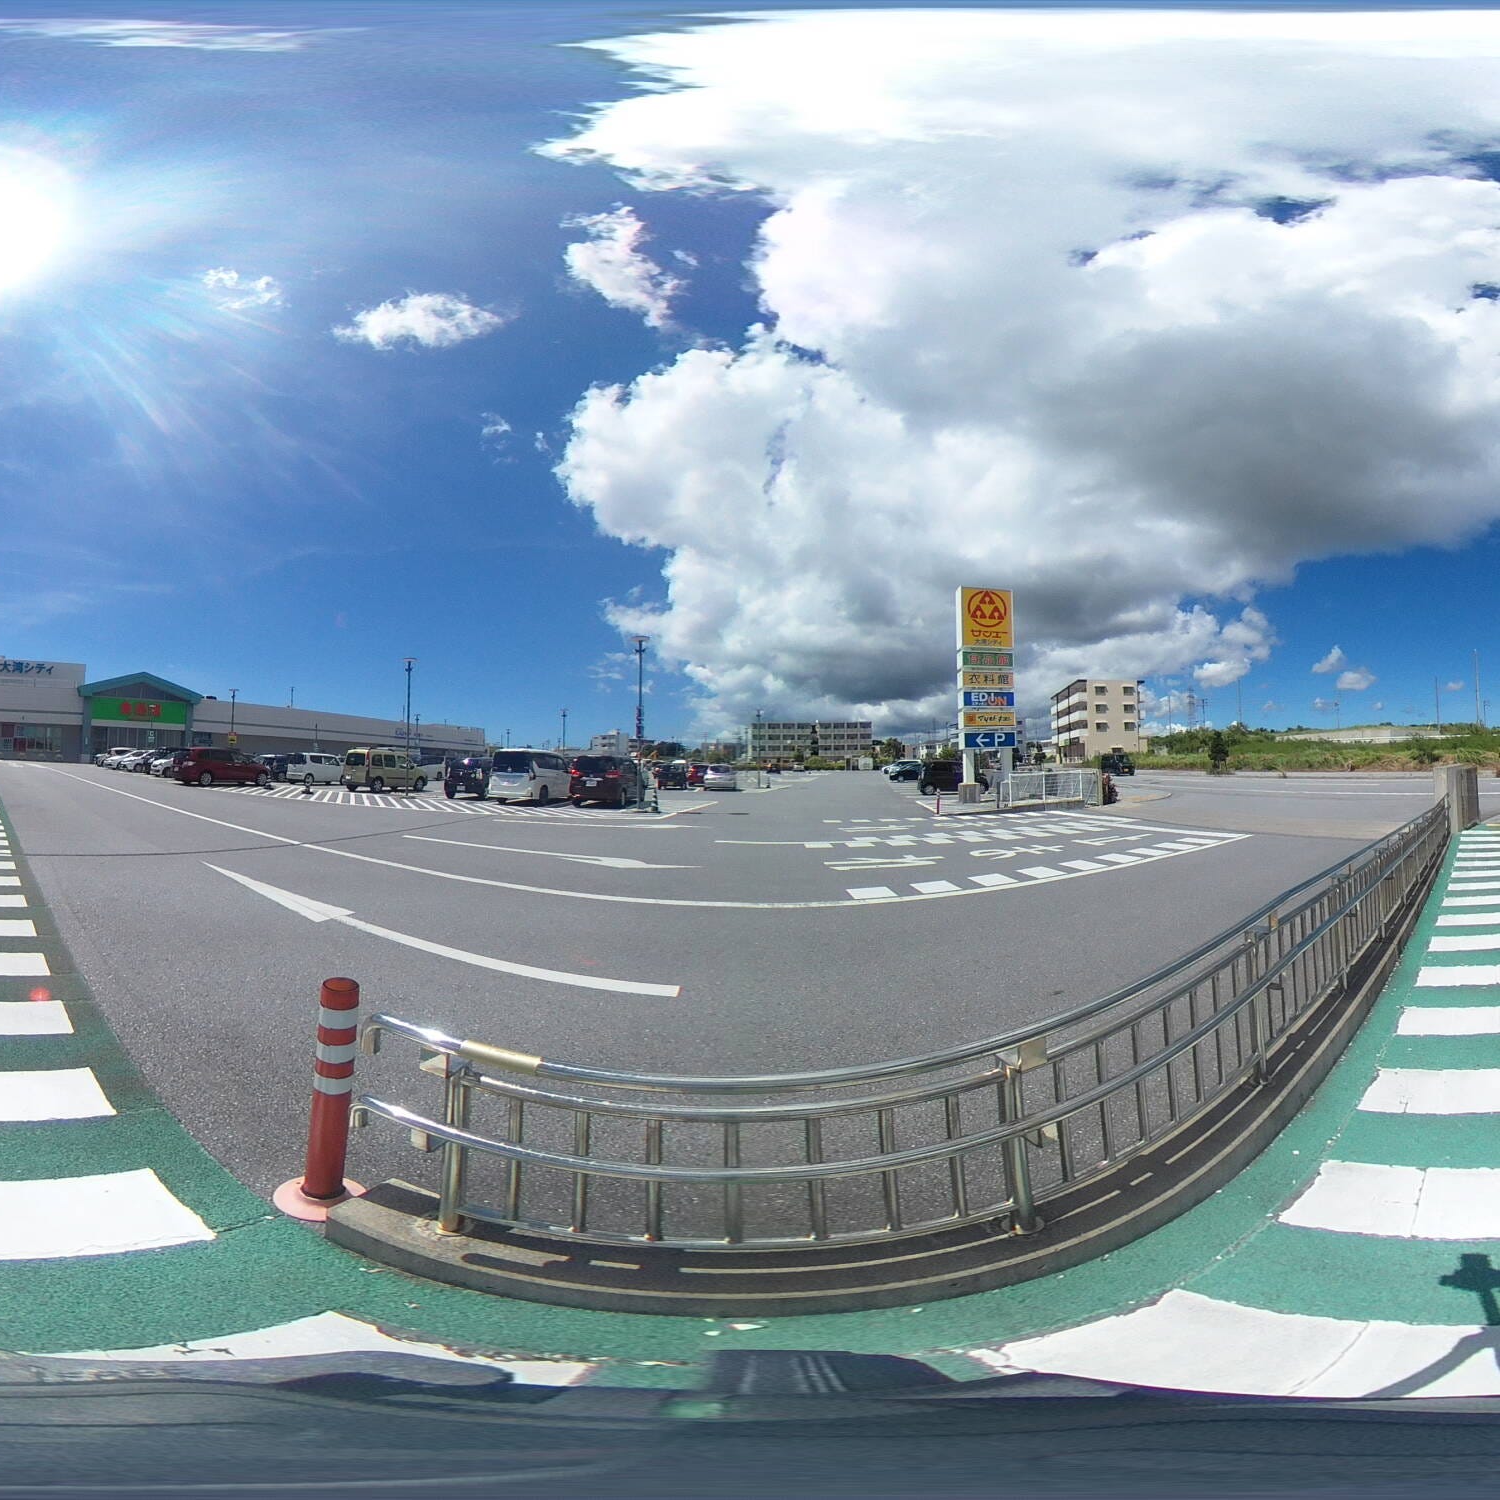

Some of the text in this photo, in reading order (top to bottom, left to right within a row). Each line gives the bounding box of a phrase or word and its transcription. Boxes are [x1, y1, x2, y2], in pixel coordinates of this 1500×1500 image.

[970, 629, 1008, 639] サンエー
[0, 660, 54, 675] 大湾シティ
[969, 673, 1009, 685] 衣料館
[995, 733, 1006, 747] P
[823, 833, 1154, 871] 止まれ
